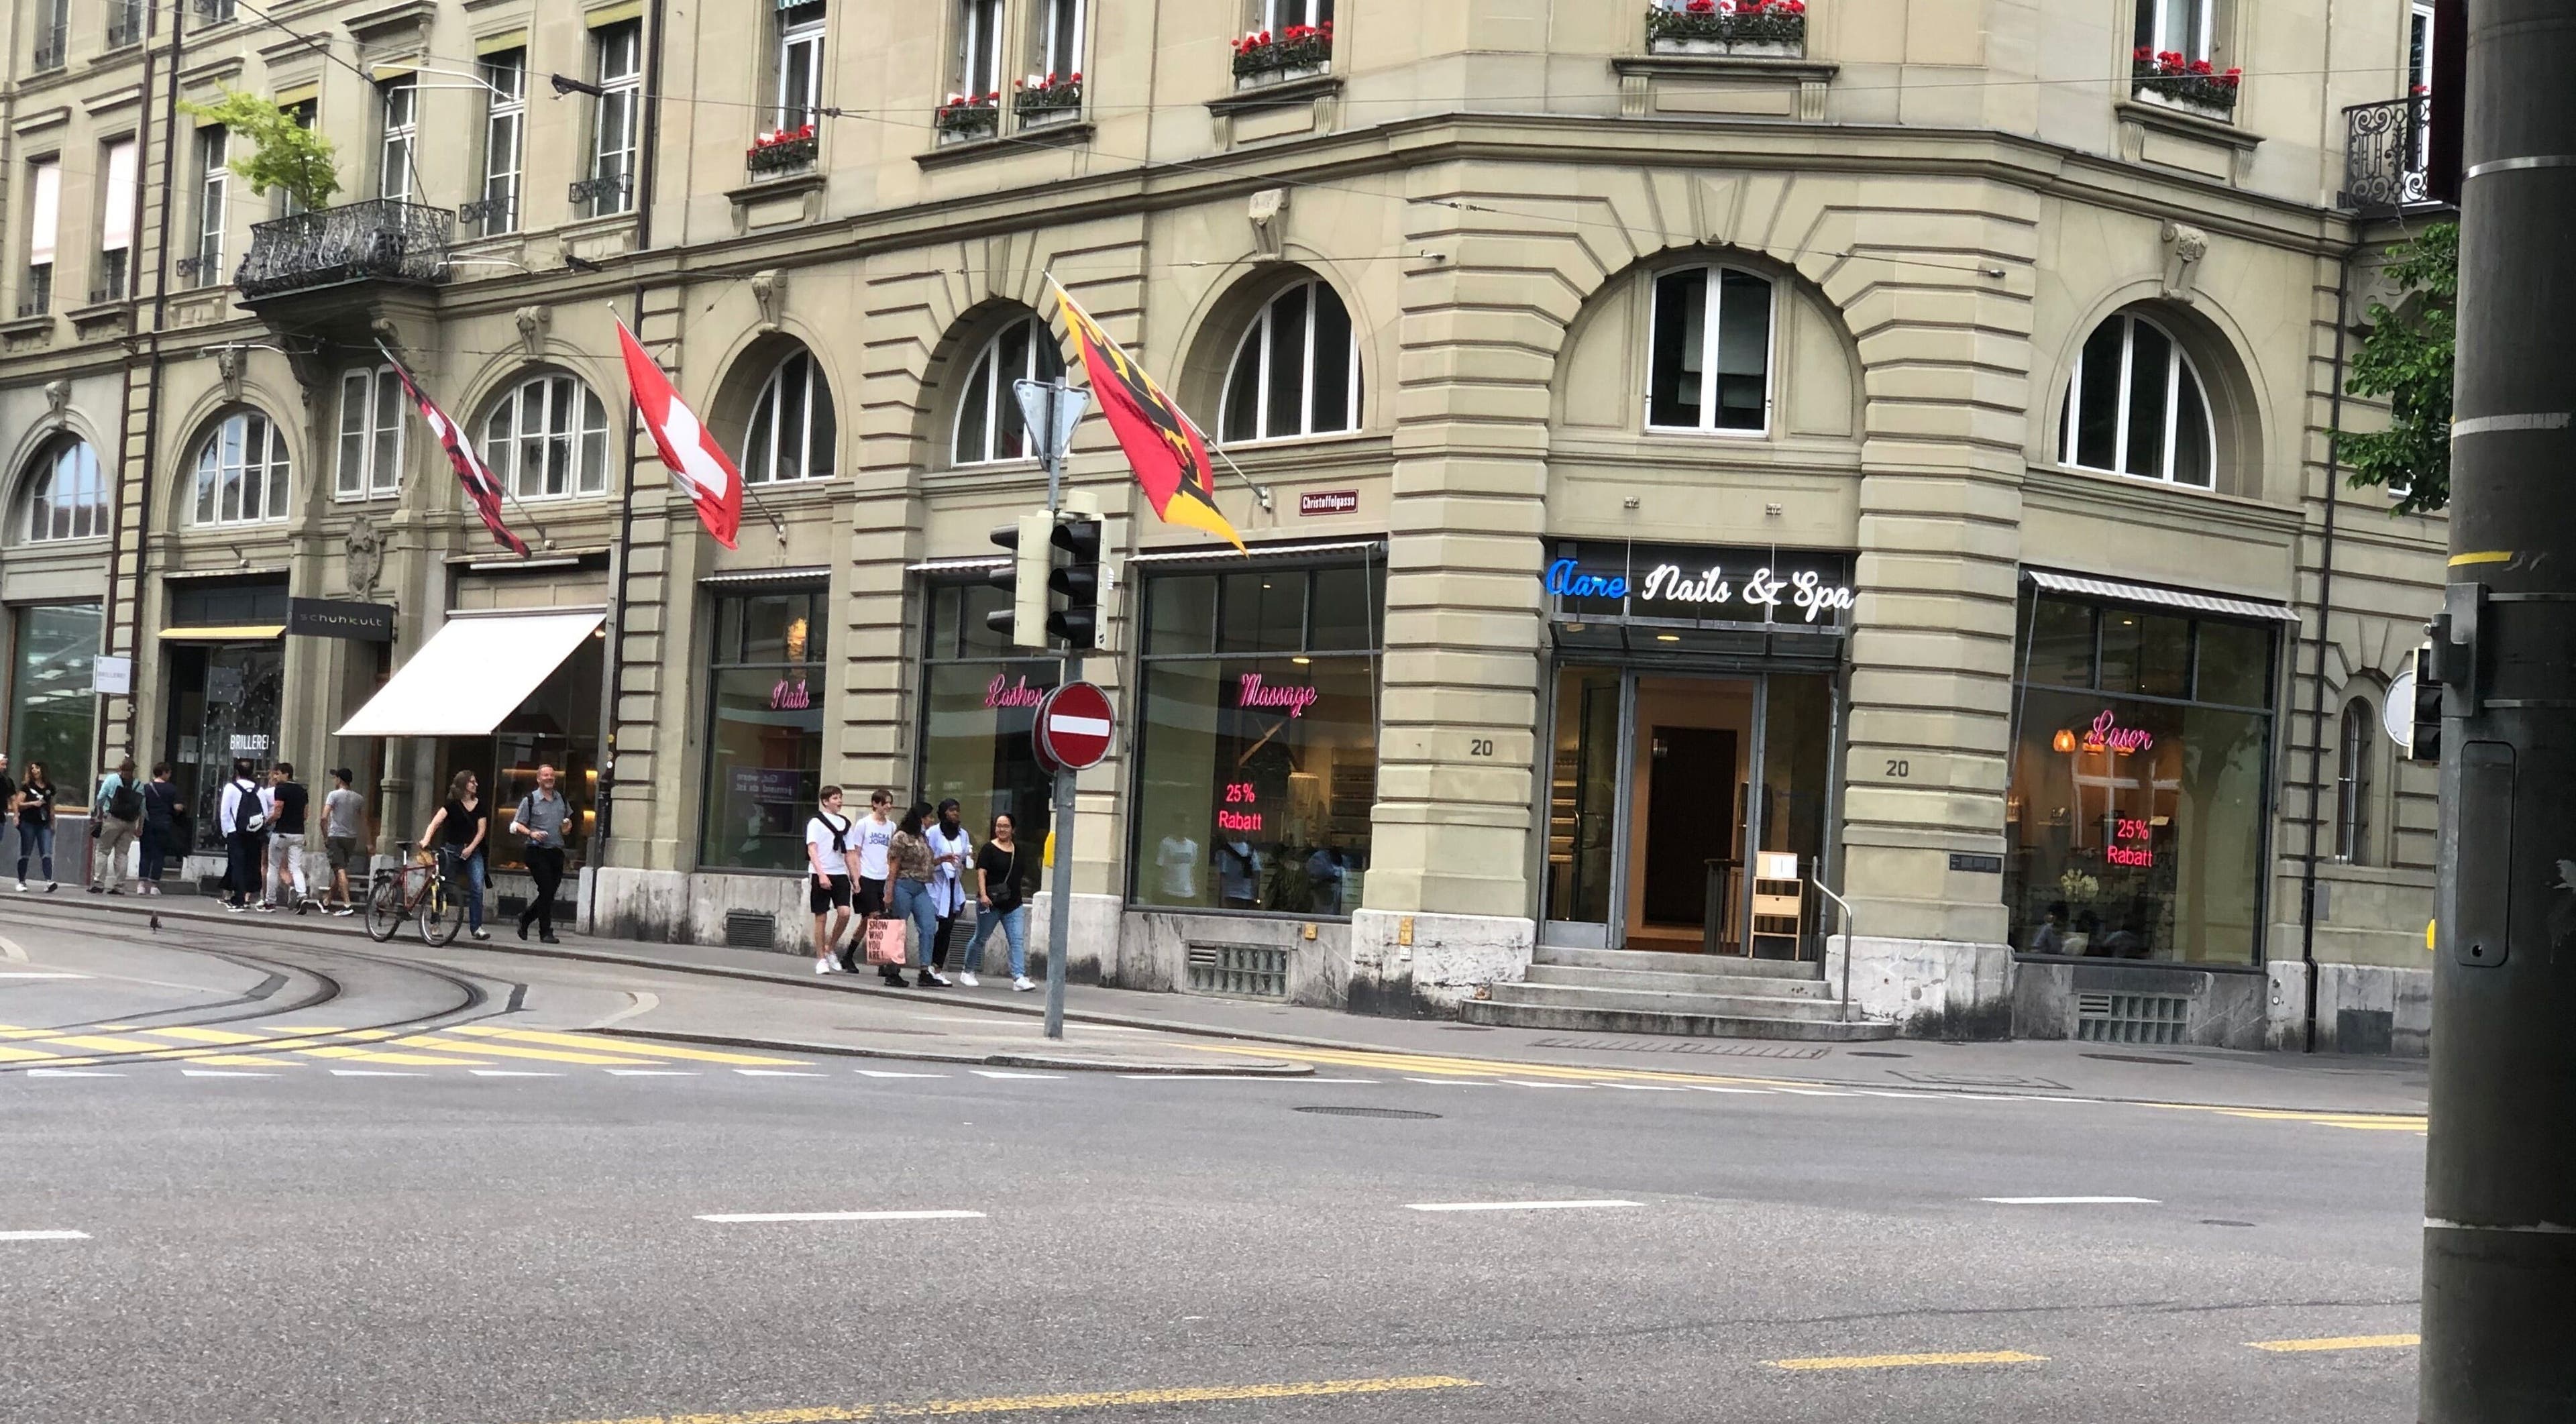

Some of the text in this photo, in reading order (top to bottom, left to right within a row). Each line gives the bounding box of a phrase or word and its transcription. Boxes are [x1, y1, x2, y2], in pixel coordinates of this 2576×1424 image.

[1303, 495, 1355, 510] Christoffelgasse
[1546, 559, 1854, 622] Aare Nails & Spa
[771, 679, 810, 709] Nails
[1240, 673, 1318, 718] Massage
[2088, 710, 2153, 751] Laser
[230, 734, 270, 750] BRILLEREI
[1471, 739, 1493, 756] 20
[1886, 760, 1909, 777] 20
[1226, 783, 1255, 803] 25%
[1219, 810, 1262, 830] Rabatt
[2117, 818, 2149, 840] 25%
[2108, 845, 2153, 867] Rabatt
[869, 921, 889, 930] SHOW
[869, 930, 883, 940] WHO
[869, 940, 881, 950] YOU
